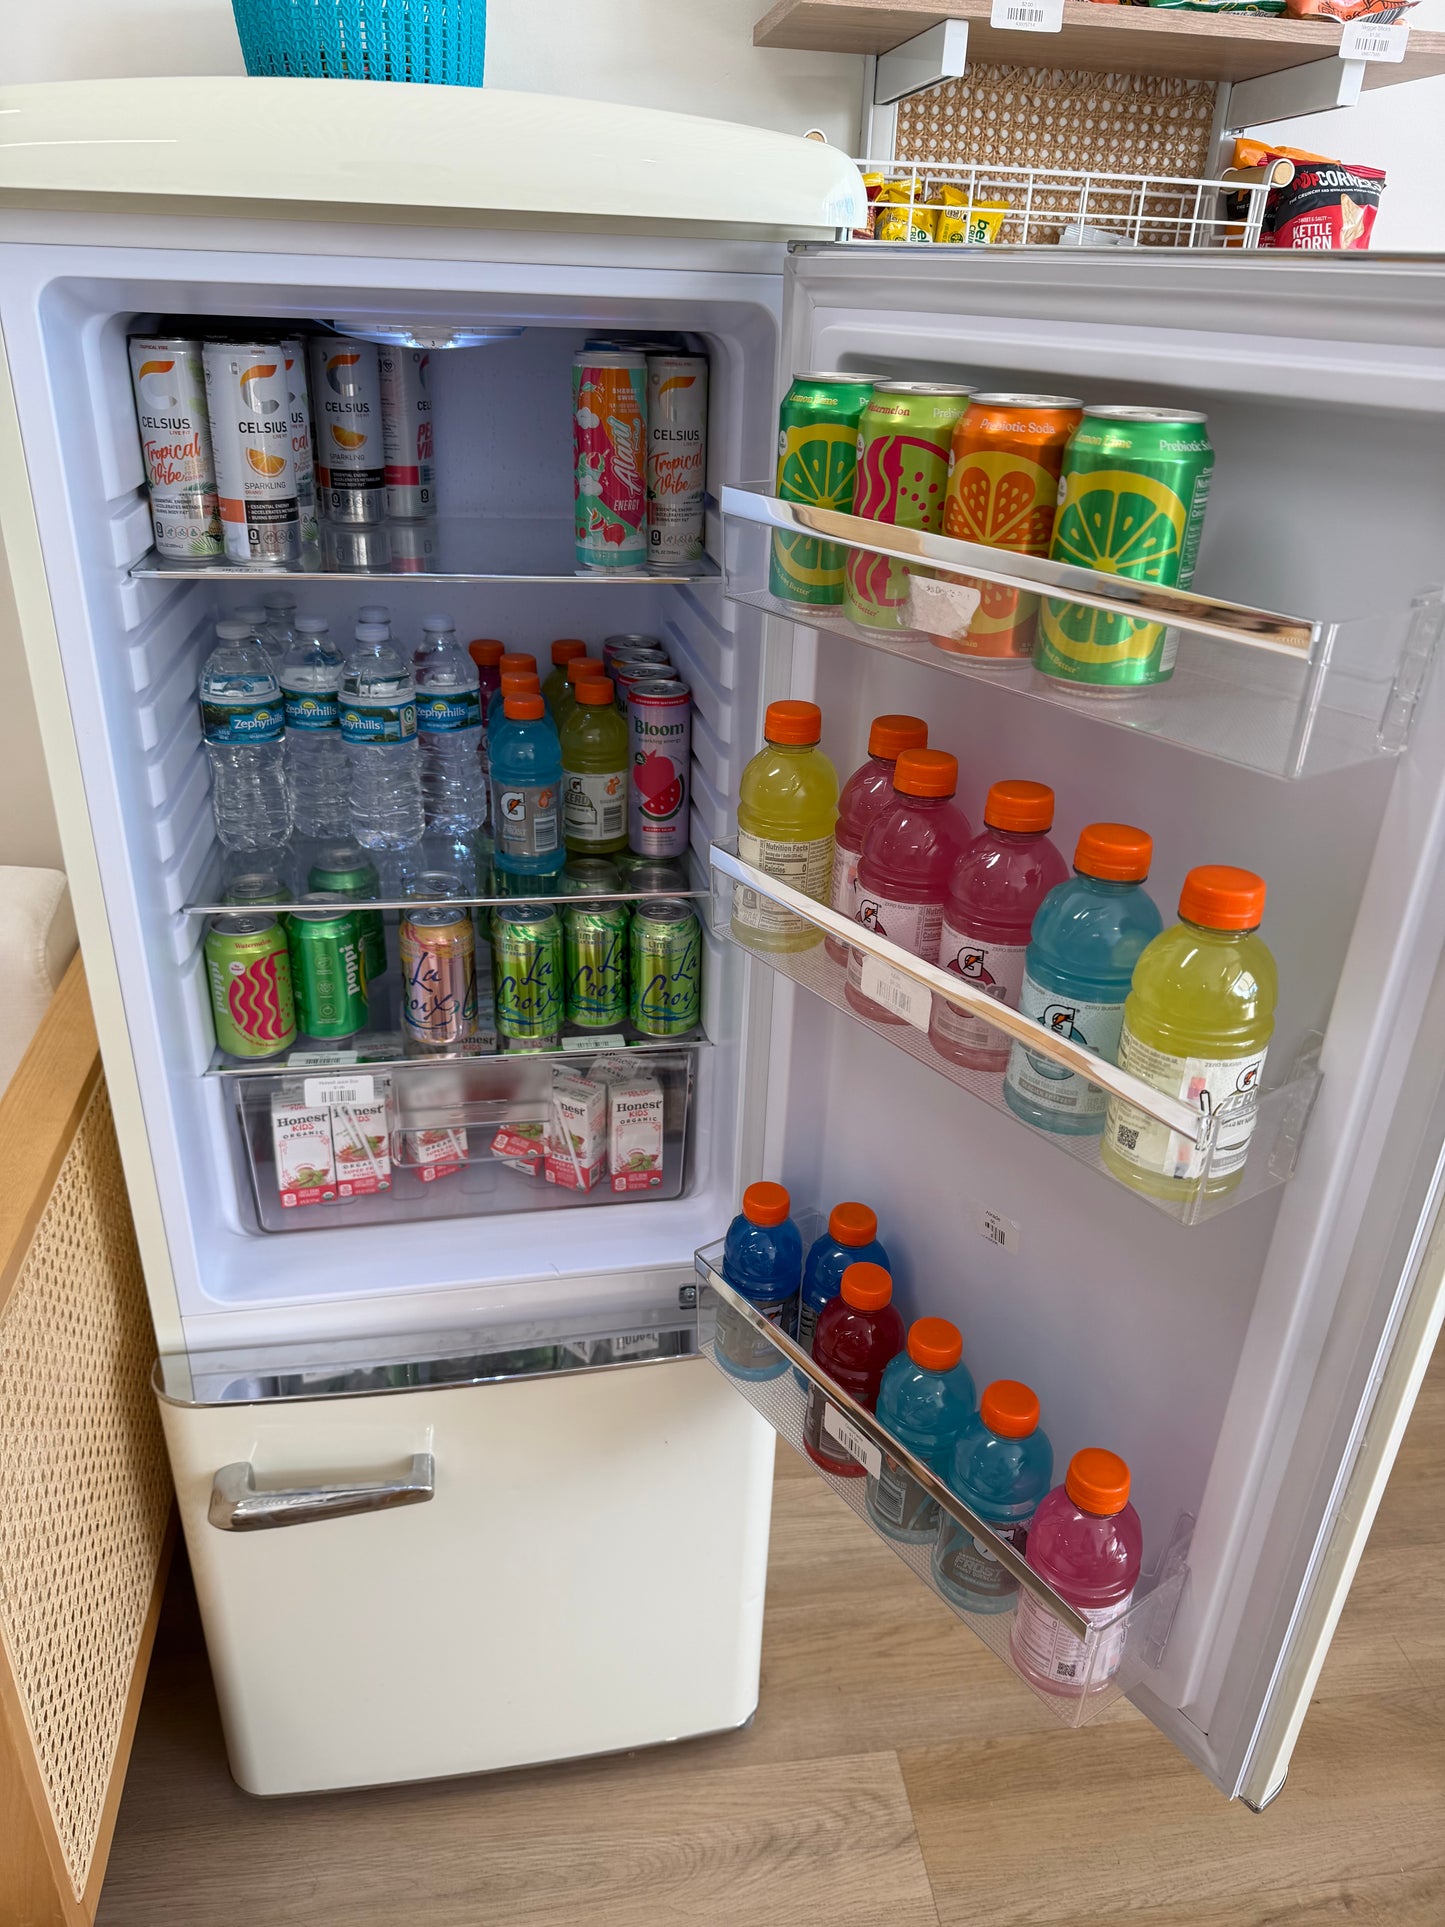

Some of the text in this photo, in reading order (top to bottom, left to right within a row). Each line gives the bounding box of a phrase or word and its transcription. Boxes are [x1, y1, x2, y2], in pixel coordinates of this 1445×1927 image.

[1298, 188, 1321, 199] CRUNCHY
[1293, 222, 1333, 240] KETTLE
[1293, 236, 1332, 250] CORN
[790, 392, 839, 406] Lemon Lime
[325, 401, 370, 413] CELSIUS
[932, 407, 964, 418] Prebio
[142, 416, 190, 430] CELSIUS
[238, 421, 288, 434] CELSIUS
[980, 418, 1056, 435] Prebiotic Soda
[653, 429, 700, 441] CELSIUS
[1103, 434, 1133, 449] Lime
[144, 432, 201, 469] Tropical
[1159, 439, 1201, 453] Prebiotic
[329, 452, 365, 461] SPARKLING
[648, 443, 702, 474] Tropical
[150, 462, 185, 485] Vibe
[244, 481, 287, 490] SPARKLING
[654, 472, 689, 496] Vibe
[613, 499, 640, 512] ENERGY
[788, 581, 810, 596] Better
[856, 602, 878, 617] Better
[1053, 655, 1077, 674] Better
[285, 703, 337, 718] Zephyrhills
[417, 707, 466, 720] Zephyrhills
[234, 713, 283, 730] Zephyrhills
[340, 717, 381, 730] phyrhills
[634, 719, 684, 736] Bloom
[765, 842, 792, 851] Nutrition
[764, 864, 807, 873] Calories 0
[234, 939, 272, 950] Watermelon
[648, 941, 672, 949] LIME
[597, 933, 624, 973] La
[520, 946, 553, 986] La
[671, 941, 697, 982] La
[339, 944, 361, 996] poppi
[409, 951, 442, 993] La
[208, 960, 229, 1015] poppi
[496, 976, 561, 1016] Croix
[411, 994, 453, 1020] oix
[460, 1036, 495, 1044] onest
[561, 1102, 586, 1117] nest
[616, 1100, 663, 1113] Honest
[276, 1113, 328, 1128] Honest
[348, 1115, 370, 1123] DS
[620, 1116, 657, 1125] ORGANIC
[628, 1109, 649, 1119] KIDS
[282, 1130, 325, 1140] ORGANIC
[291, 1123, 315, 1133] KIDS
[425, 1135, 462, 1152] ORGANC
[343, 1159, 384, 1170] ORGAC
[954, 1556, 1003, 1577] FROST
